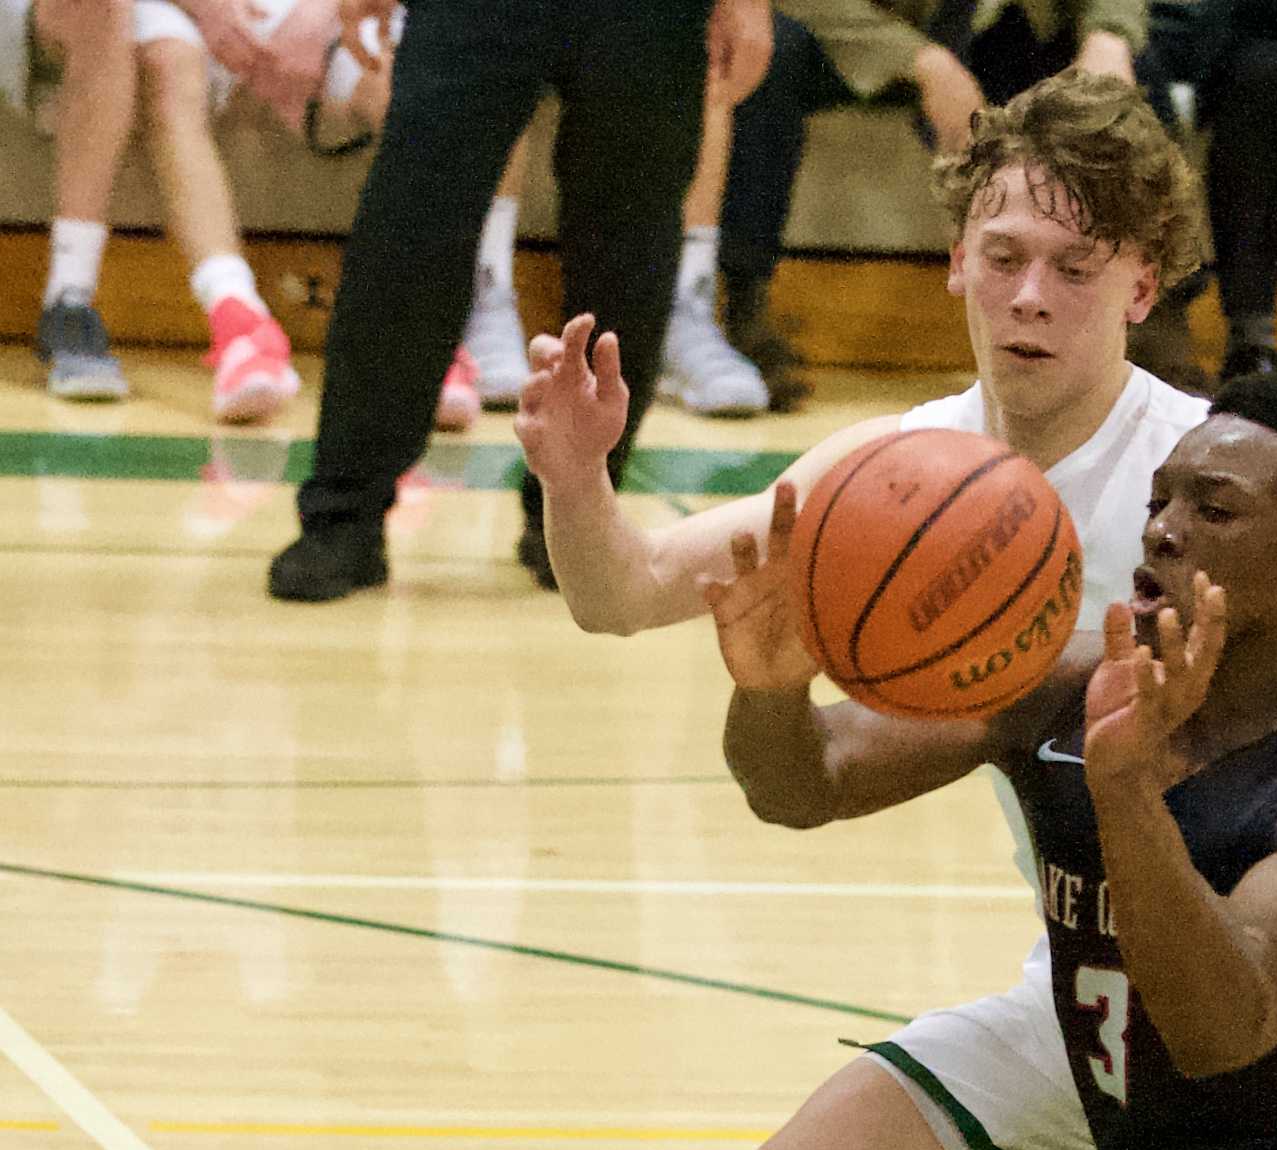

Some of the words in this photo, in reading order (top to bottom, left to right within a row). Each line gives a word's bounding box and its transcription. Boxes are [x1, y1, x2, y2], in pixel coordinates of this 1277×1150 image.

[949, 550, 1081, 689] Wilson
[1041, 858, 1083, 930] KE
[1074, 964, 1129, 1106] 3
